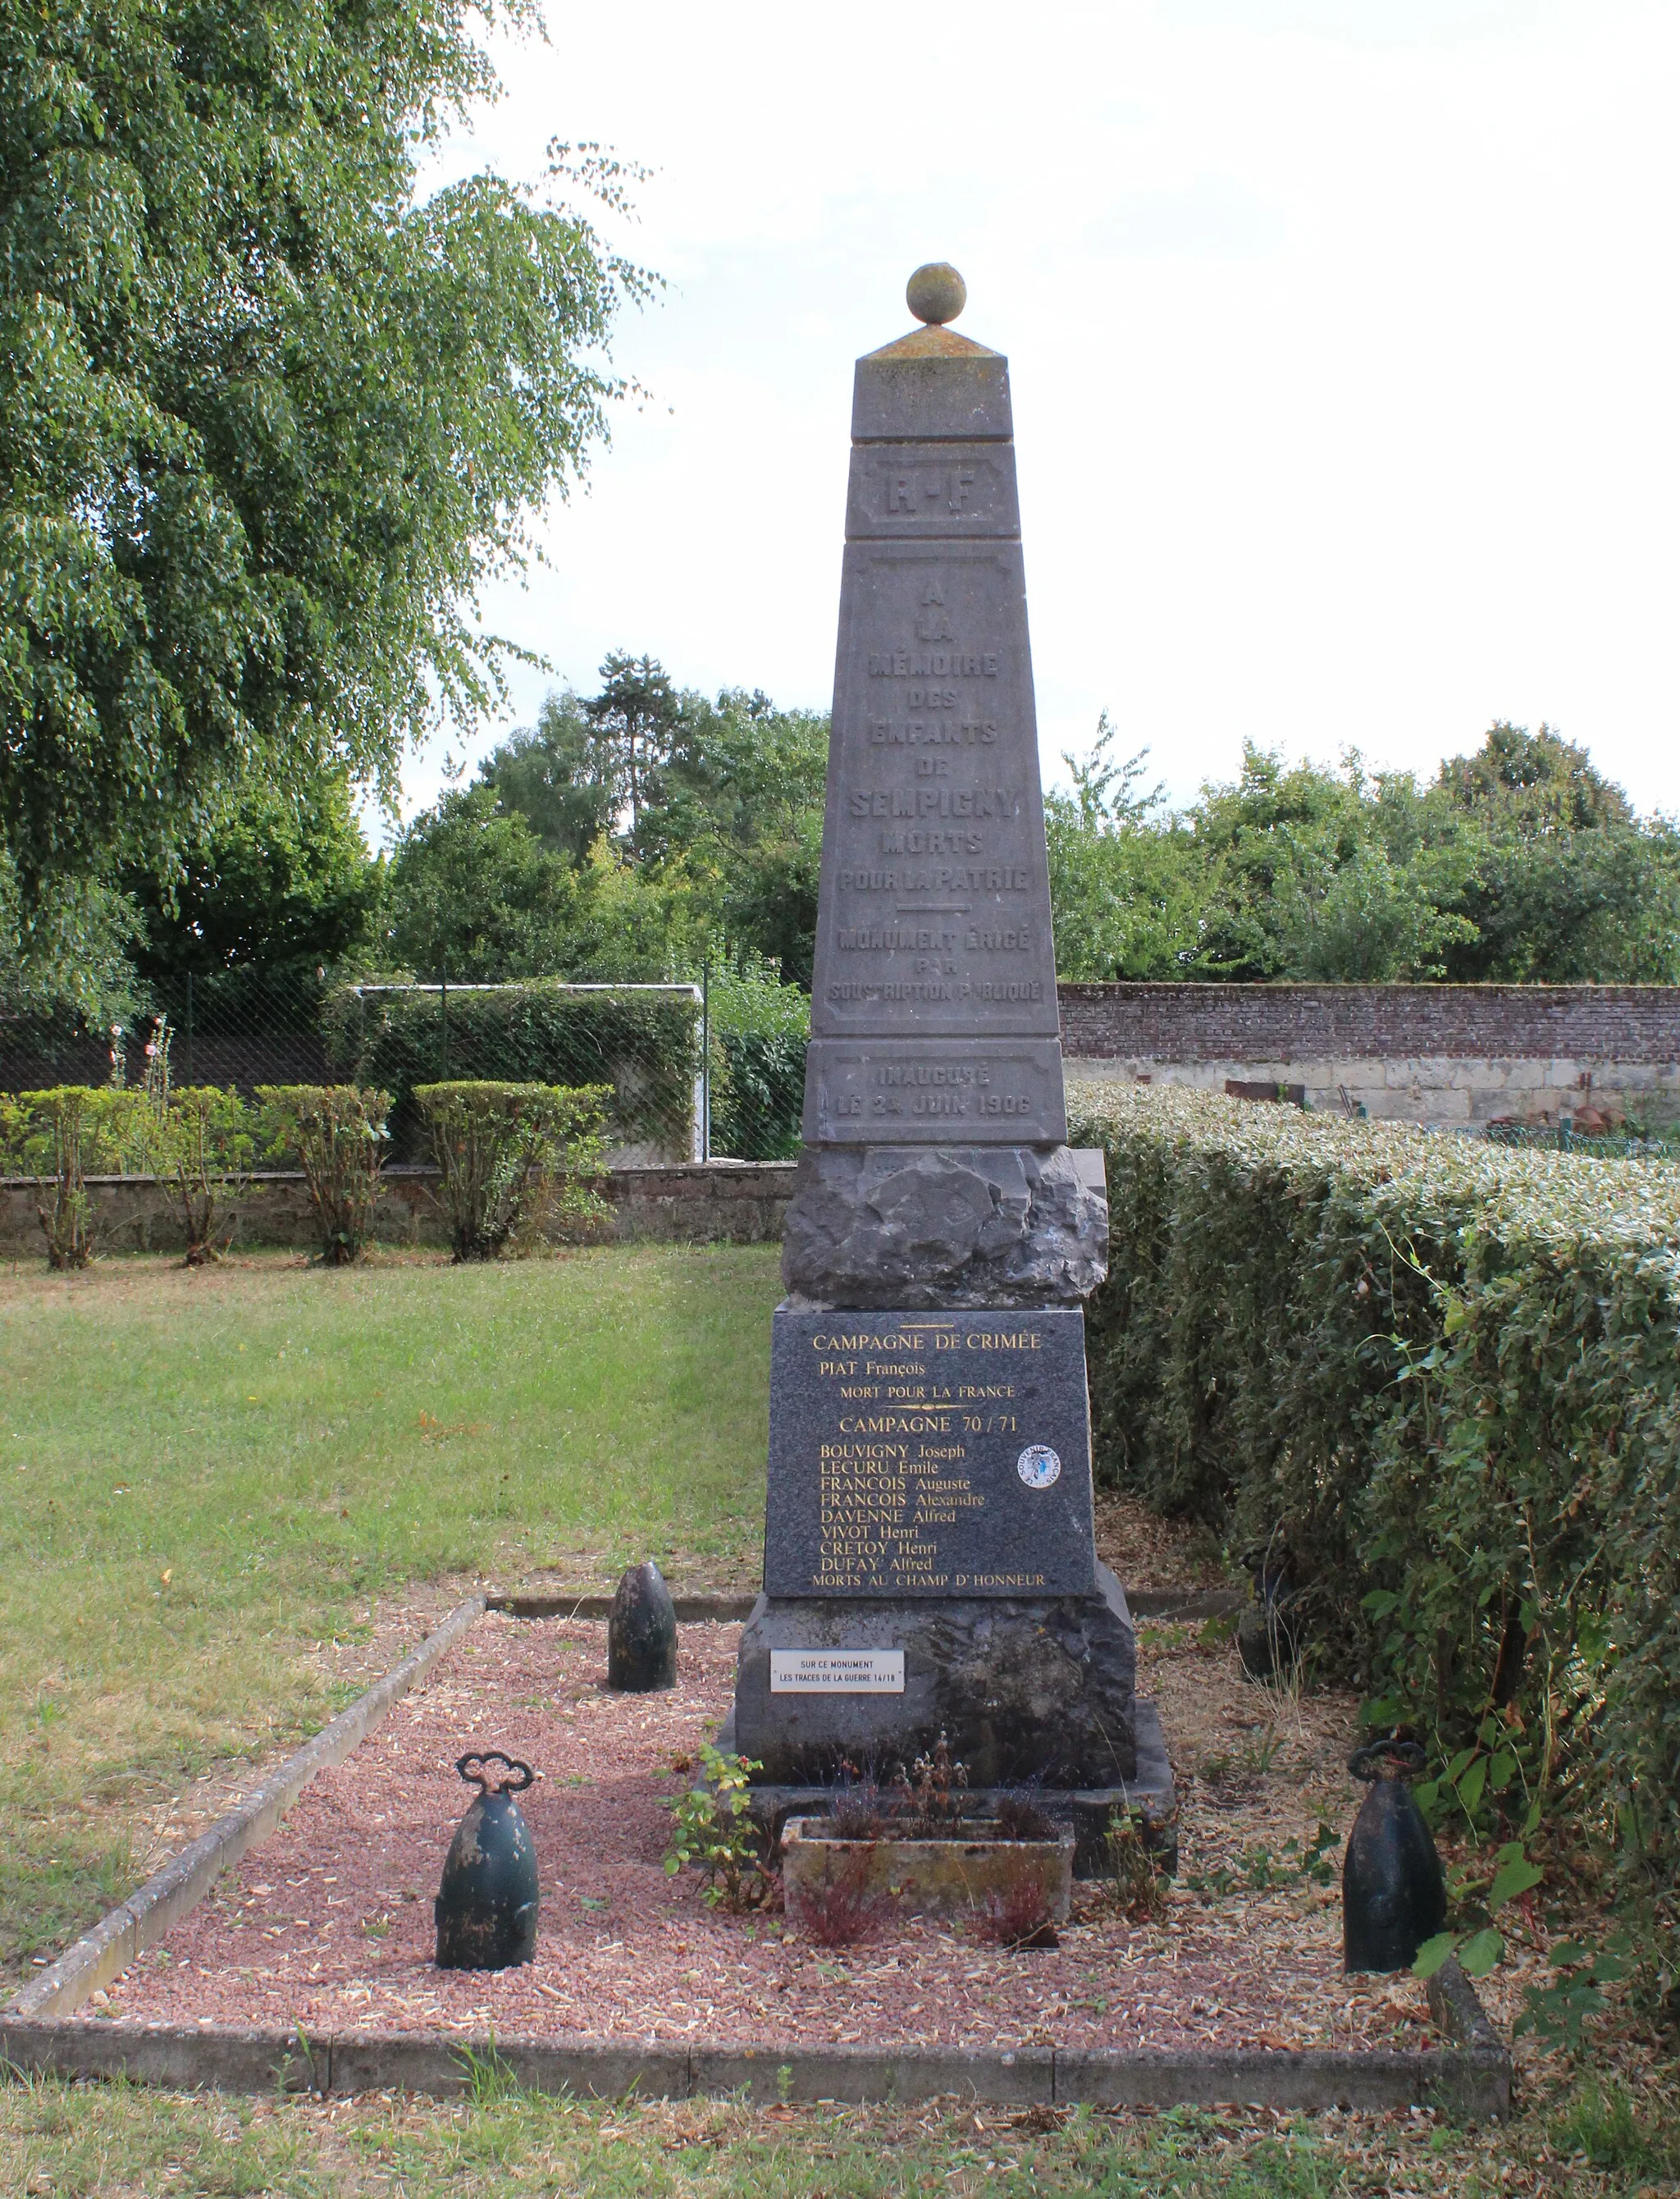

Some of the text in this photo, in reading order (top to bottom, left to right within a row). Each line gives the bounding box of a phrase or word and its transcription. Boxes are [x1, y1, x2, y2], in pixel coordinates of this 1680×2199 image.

[921, 579, 945, 606] A
[915, 614, 955, 642] LA
[869, 651, 998, 677] MÉMOIRE
[908, 688, 956, 708] DES
[870, 720, 998, 745] ENFANTS
[915, 756, 949, 776] DE
[850, 789, 1018, 819] SEMPIGNY
[881, 830, 984, 854] MORTS
[839, 867, 1029, 891] POUR LA PATRIE
[838, 923, 1031, 951] MONUMENT ÉRIGÉ
[913, 958, 958, 975] PAR
[878, 1062, 990, 1086] INAUGURÉ
[837, 1095, 862, 1115] LE
[912, 1095, 970, 1115] JUIN
[979, 1095, 1031, 1114] 1906
[813, 1329, 1042, 1351] CAMPAGNE DE CRIMÉE
[819, 1360, 926, 1378] PIAT François
[840, 1385, 1016, 1398] MORT POUR LA FRANCE
[838, 1417, 952, 1433] CAMPAGNE
[820, 1444, 966, 1461] BOUVIGNY Joseph
[1019, 1447, 1044, 1476] SOUVENIR
[820, 1461, 939, 1474] LECURU Emile
[820, 1477, 971, 1493] FRANCOIS Auguste
[820, 1493, 985, 1507] FRANCOIS Alexandre
[821, 1509, 956, 1524] DAVENNE Alfred
[821, 1525, 920, 1539] VIVOT Henri
[820, 1541, 938, 1556] CRETOY Henri
[821, 1557, 933, 1571] DUFAY Alfred
[813, 1574, 861, 1586] MORTS
[869, 1574, 888, 1586] AU
[897, 1574, 948, 1586] CHAMP
[800, 1660, 874, 1669] SUR CE MONUMENT
[779, 1673, 896, 1682] LES TRACES DE LA GUERRE 14/18
